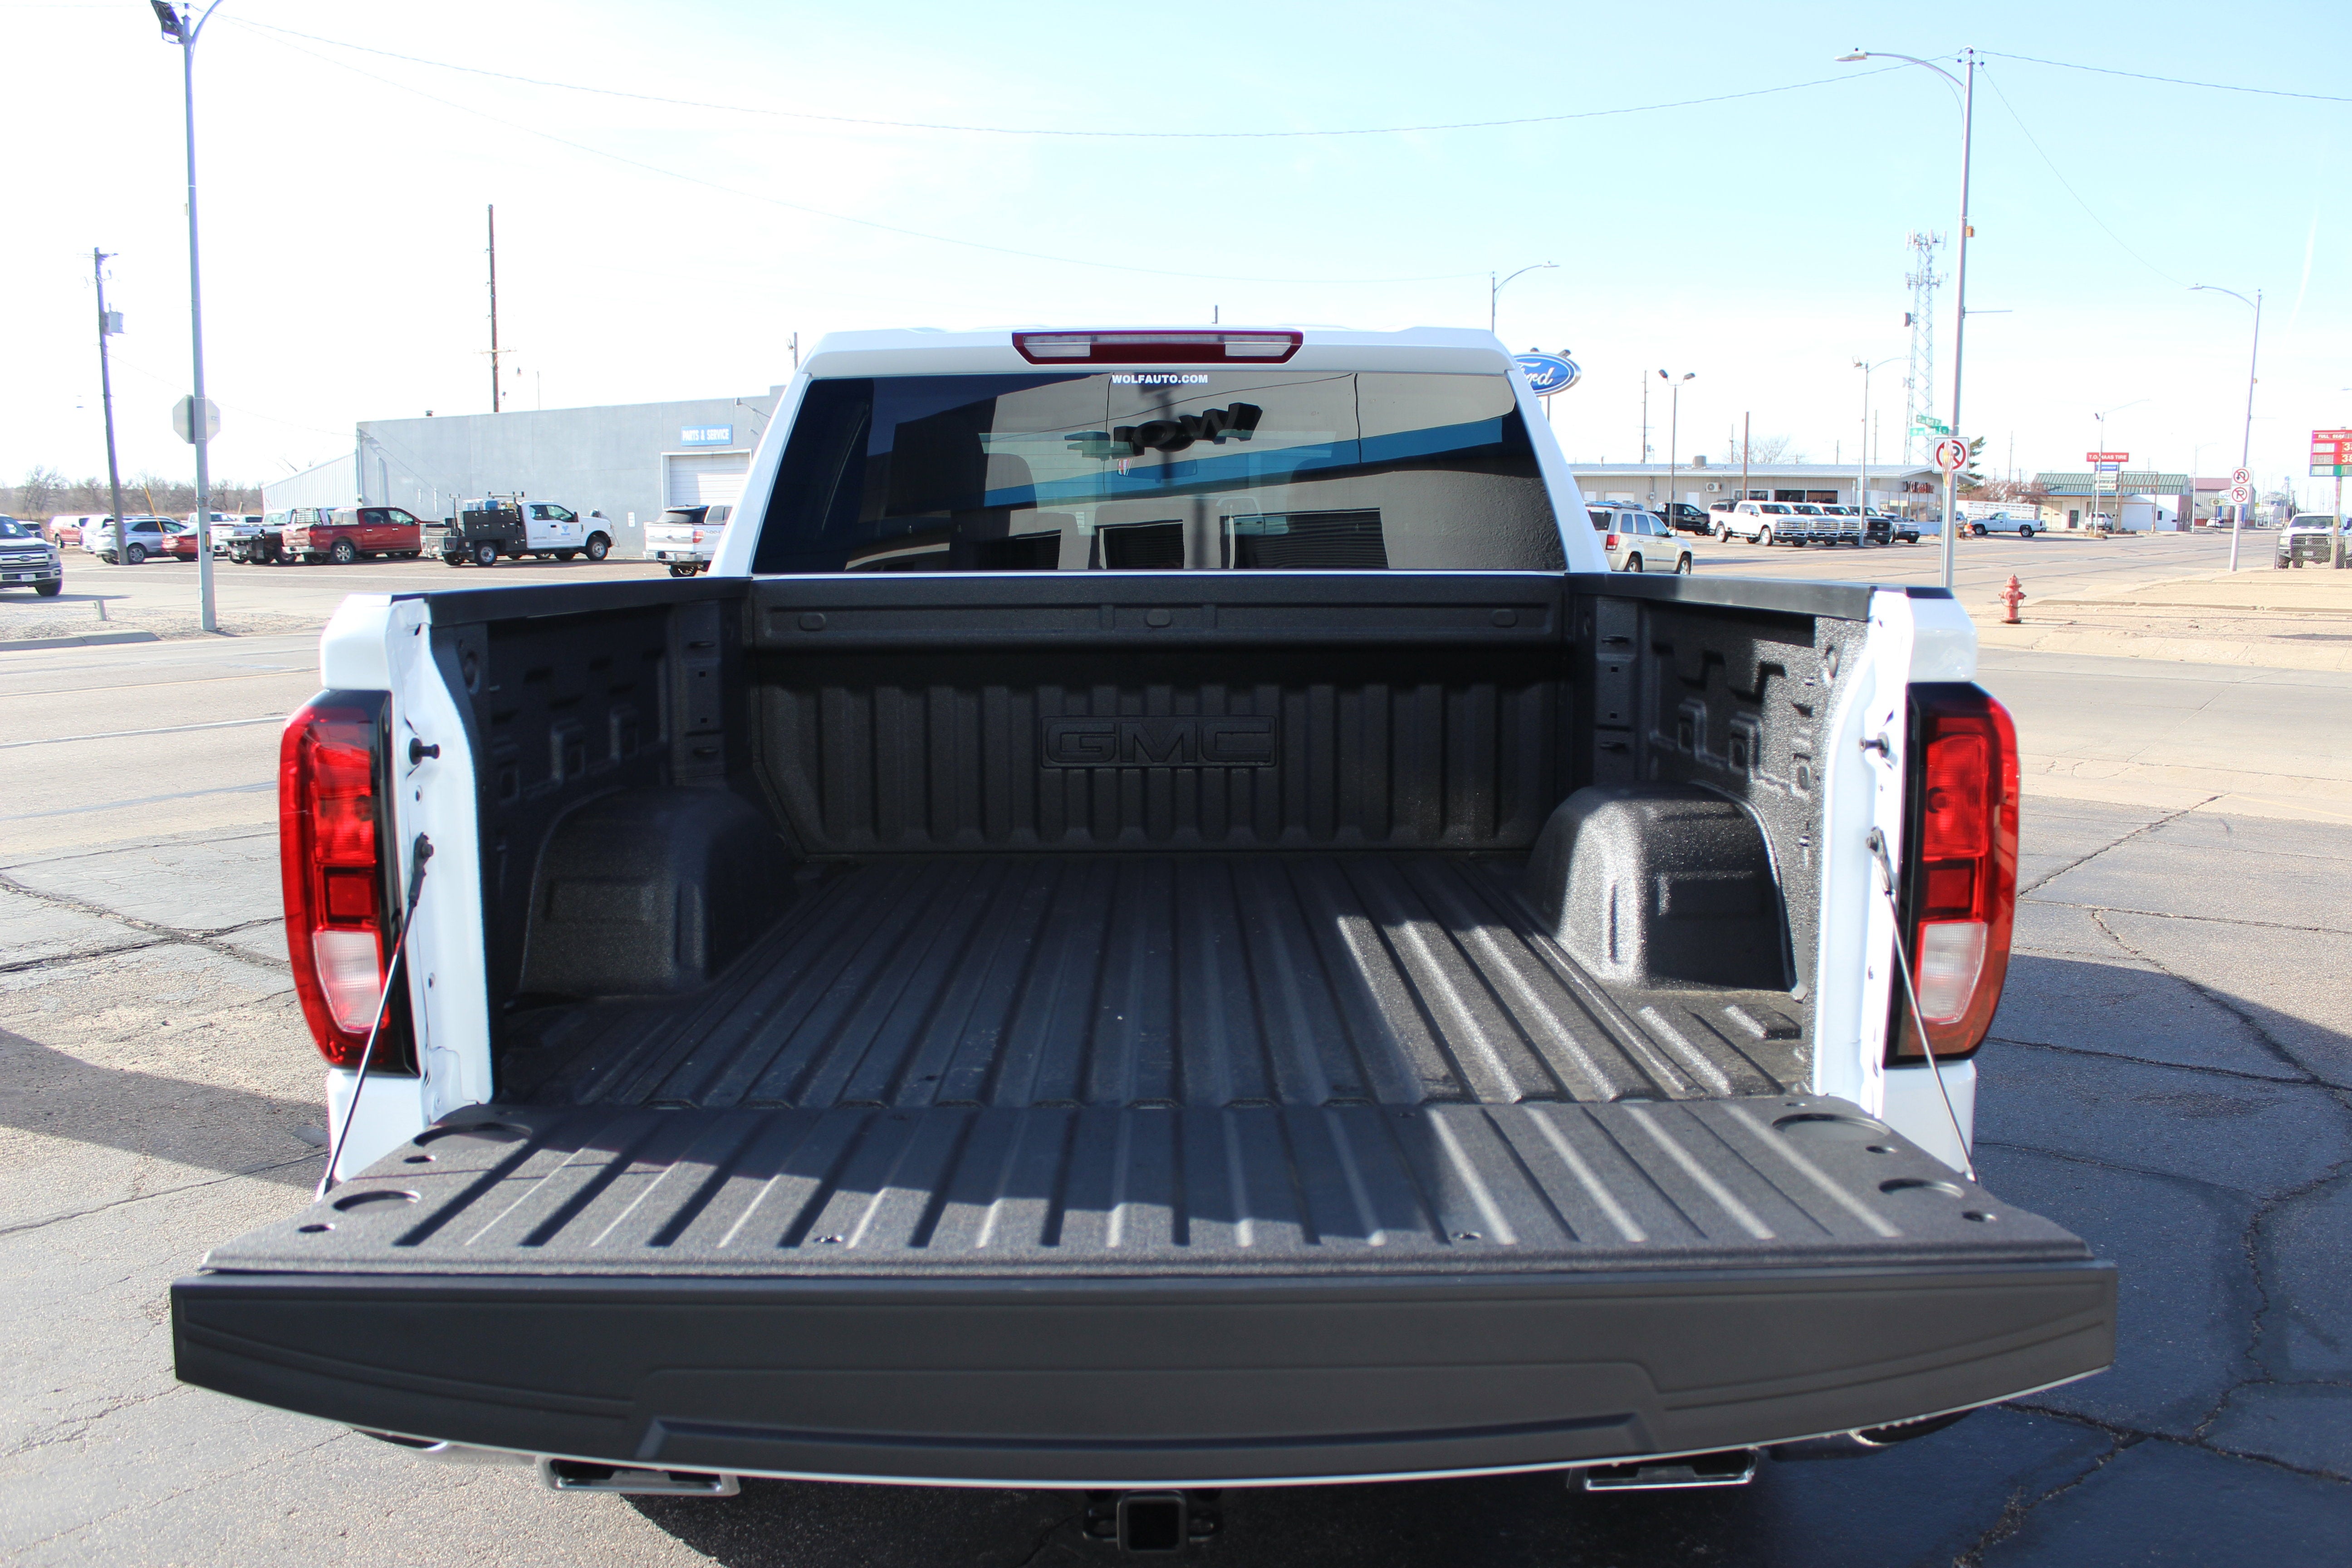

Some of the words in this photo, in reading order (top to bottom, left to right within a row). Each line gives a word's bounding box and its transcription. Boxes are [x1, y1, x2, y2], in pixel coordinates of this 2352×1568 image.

[1112, 374, 1208, 384] WOLFAUTO.COM
[682, 430, 699, 441] PARTS
[701, 429, 705, 441] &
[706, 428, 729, 440] SERVICE
[1046, 722, 1271, 763] GMC
